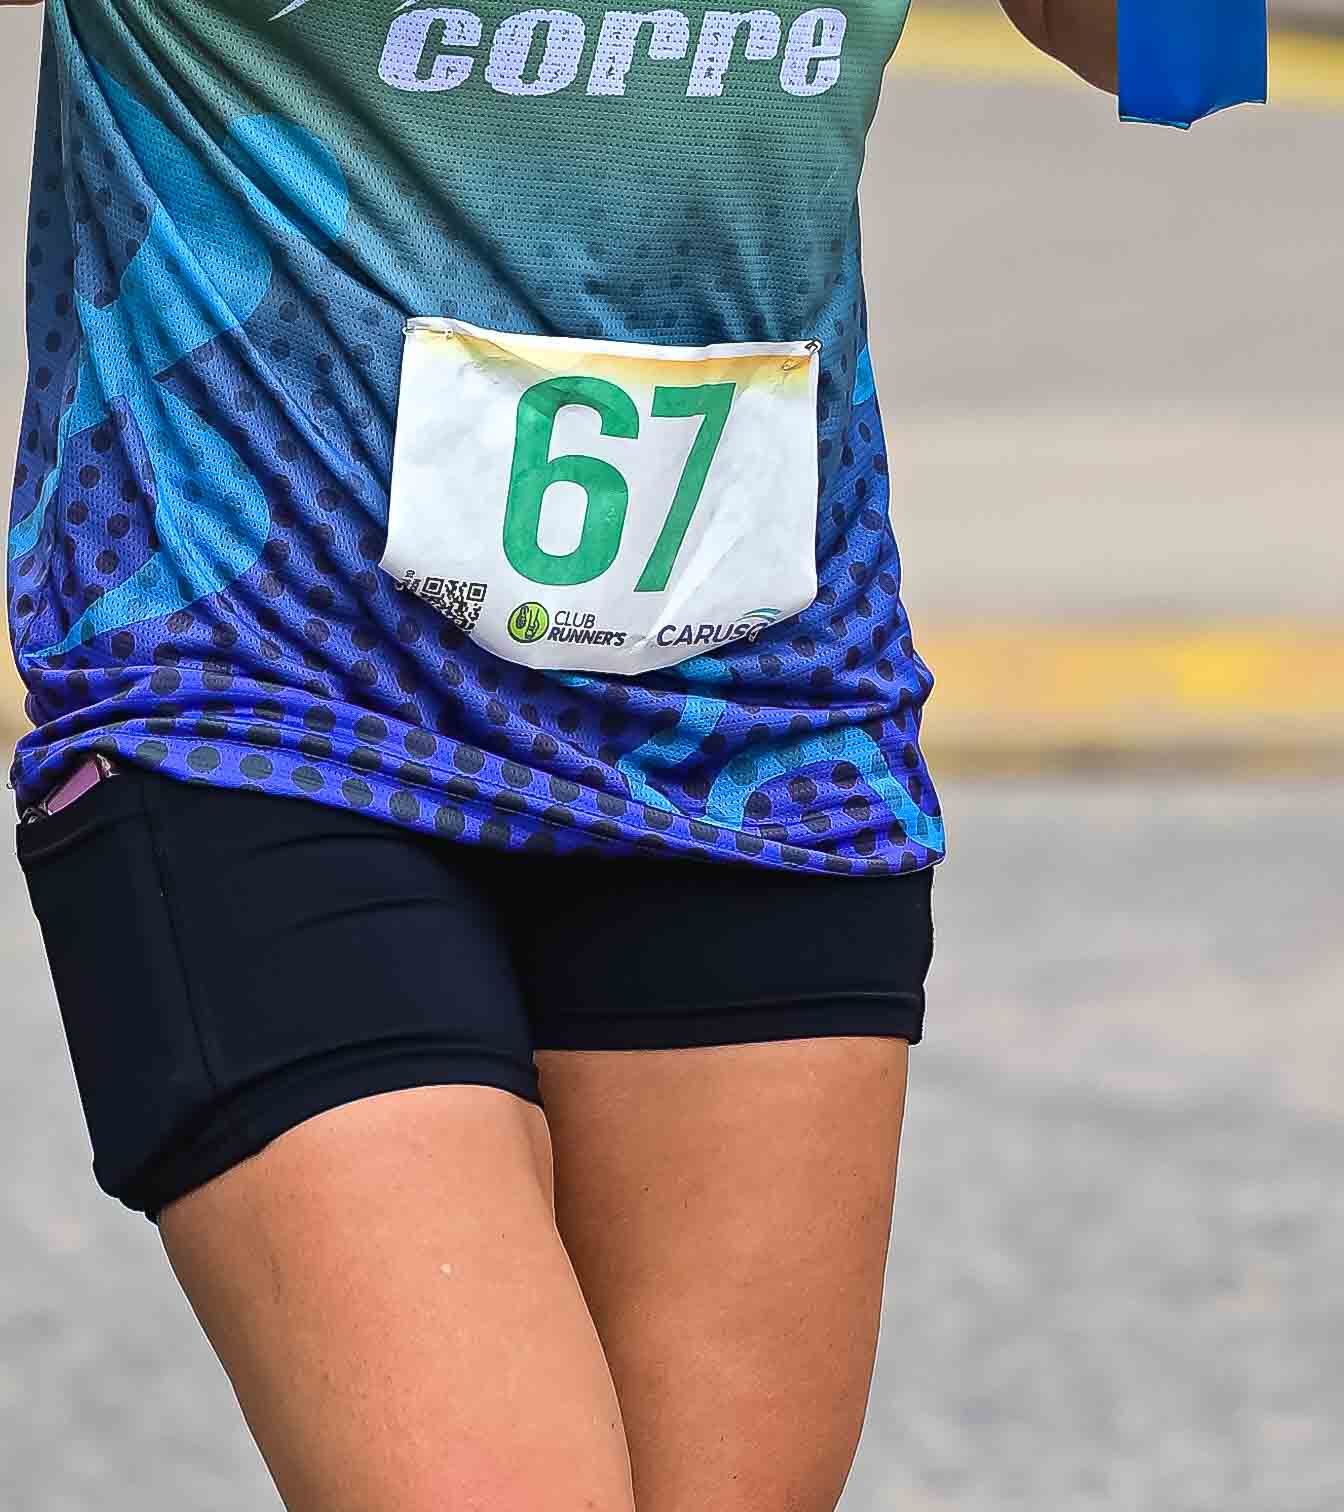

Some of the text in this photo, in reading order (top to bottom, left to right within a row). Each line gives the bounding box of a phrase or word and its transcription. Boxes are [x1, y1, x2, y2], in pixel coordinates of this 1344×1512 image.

[377, 7, 848, 98] corre
[503, 376, 737, 593] 67
[547, 628, 627, 647] RUNNER'S
[554, 610, 596, 628] CLUB
